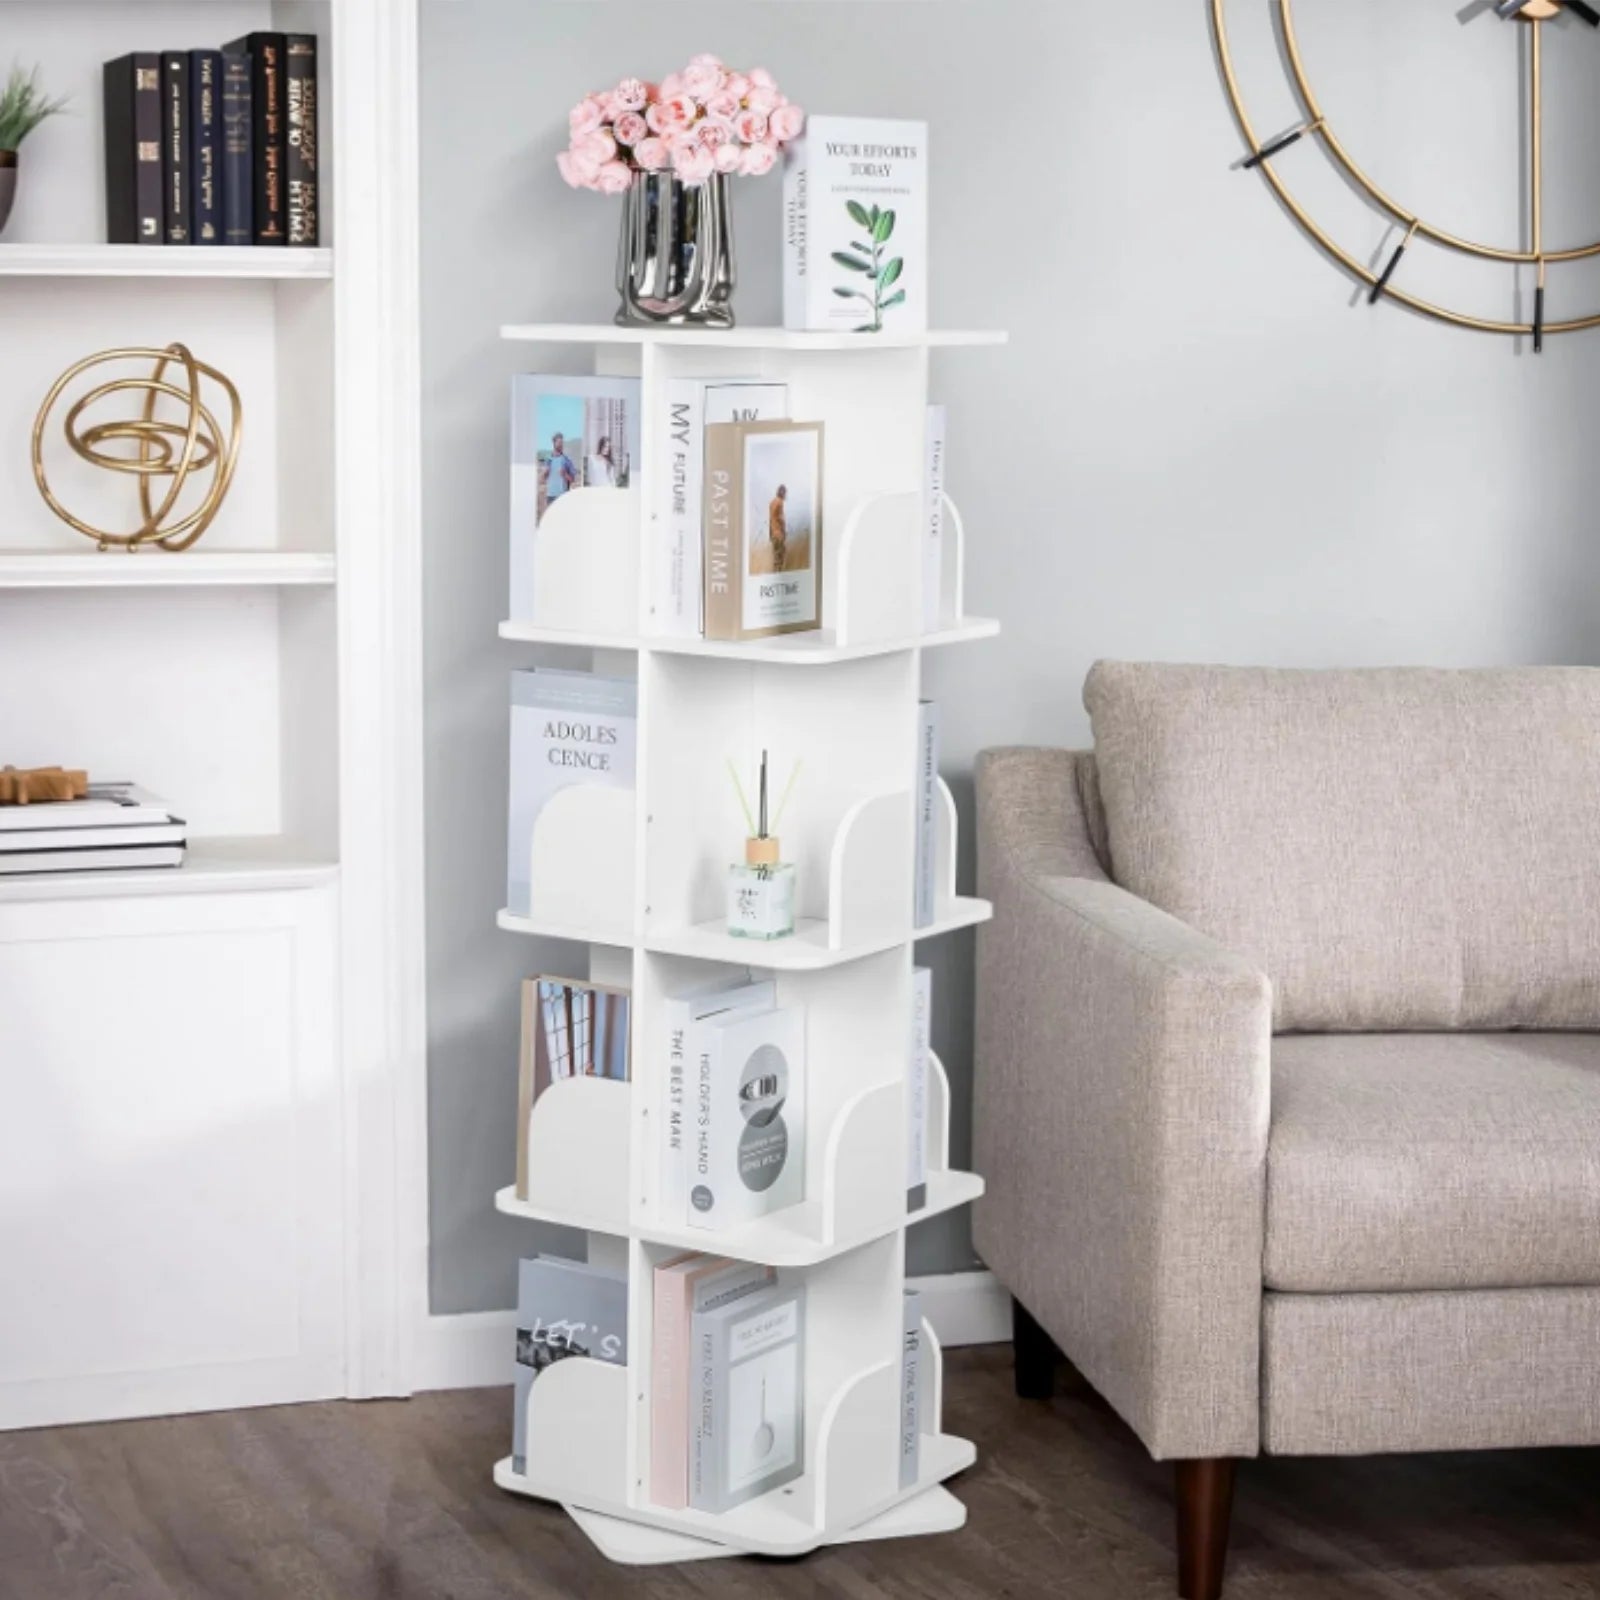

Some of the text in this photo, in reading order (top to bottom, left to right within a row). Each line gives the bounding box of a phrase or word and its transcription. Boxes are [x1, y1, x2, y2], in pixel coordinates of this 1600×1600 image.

[826, 142, 918, 158] YOUR EFFORTS
[848, 162, 892, 176] TODAY
[788, 198, 797, 247] TODAY
[798, 169, 808, 276] YOUR EFFORTS
[671, 402, 690, 446] MY
[672, 452, 686, 515] FUTURE
[711, 470, 730, 594] PAST TIME
[542, 721, 618, 744] ADOLES
[548, 748, 610, 771] CENCE
[669, 1029, 684, 1150] THE BEST MAN
[697, 1131, 708, 1174] HAND
[530, 1317, 622, 1358] LET'S
